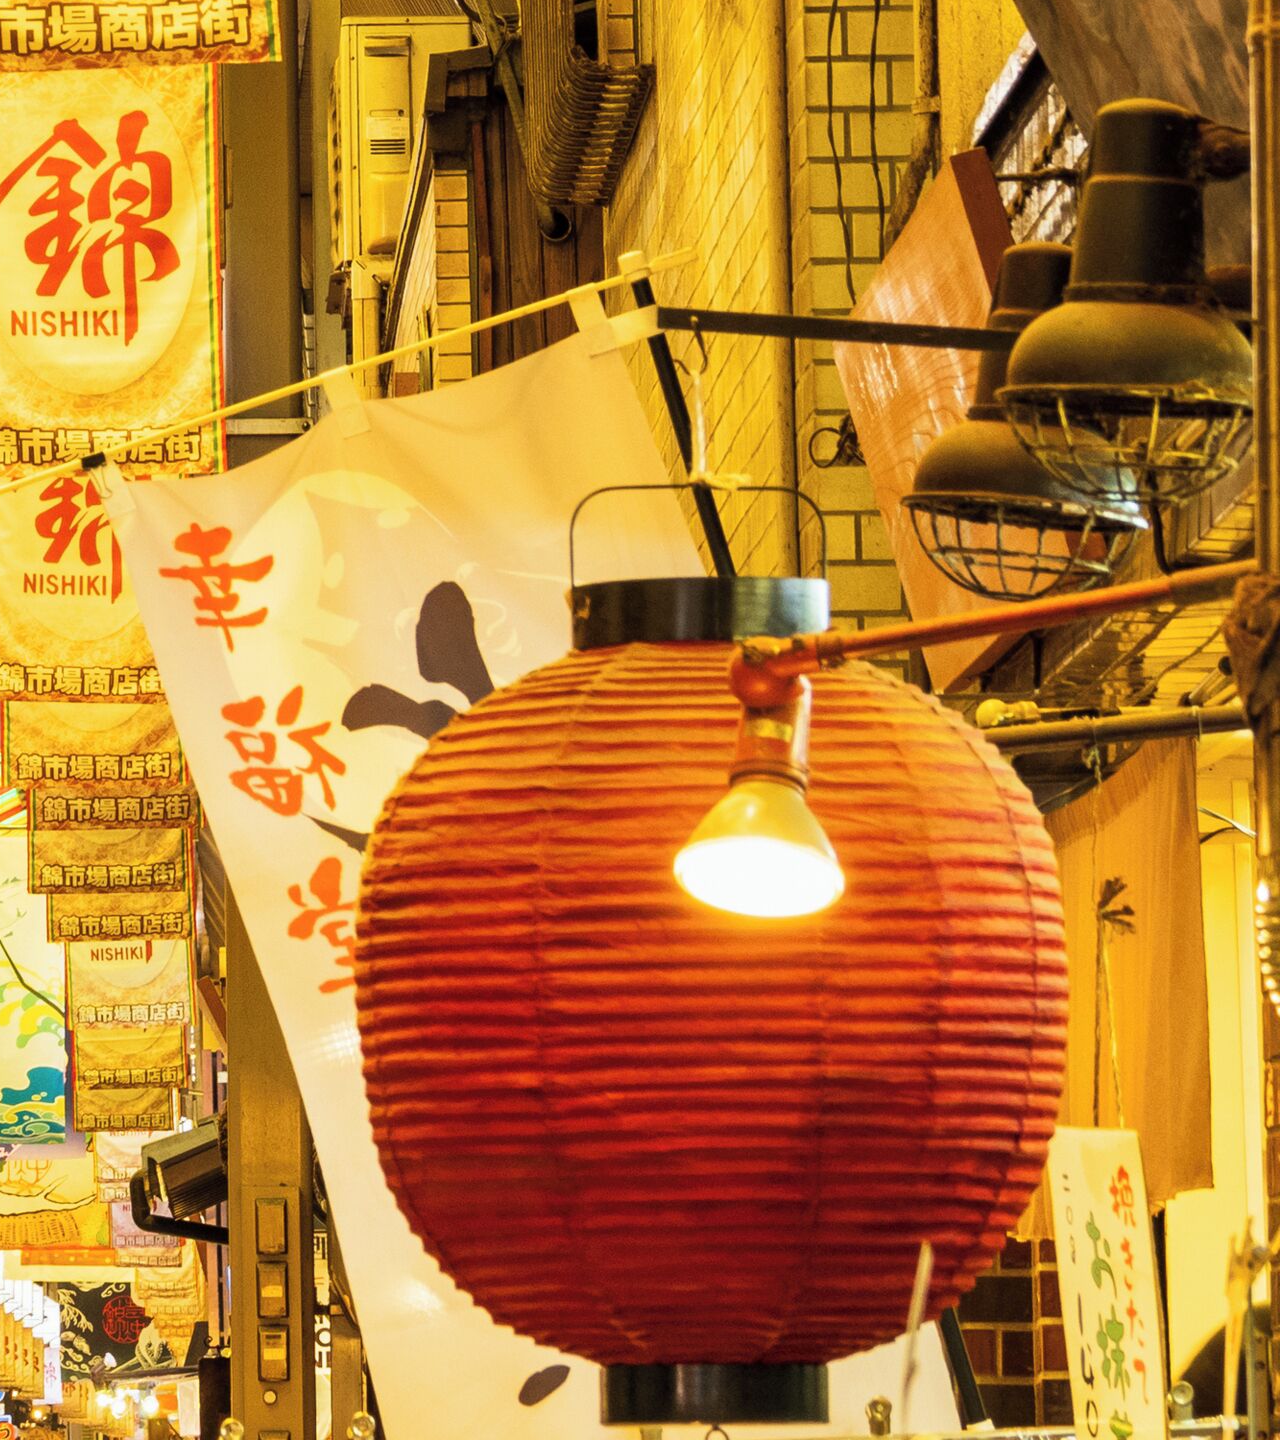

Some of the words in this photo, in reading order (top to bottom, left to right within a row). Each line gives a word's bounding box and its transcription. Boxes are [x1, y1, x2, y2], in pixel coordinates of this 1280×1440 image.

[11, 310, 119, 337] NISHIKI
[23, 572, 107, 597] NISHIKI
[16, 753, 172, 781] 錦市場商店街
[42, 796, 191, 824] 錦市場商店街
[40, 863, 177, 889] 錦市場商店街
[59, 914, 184, 937] 錦市場商店街
[90, 945, 144, 963] NISHIKI
[78, 1001, 184, 1025] 錦市場商店街
[84, 1068, 178, 1086] 錦市場商店街
